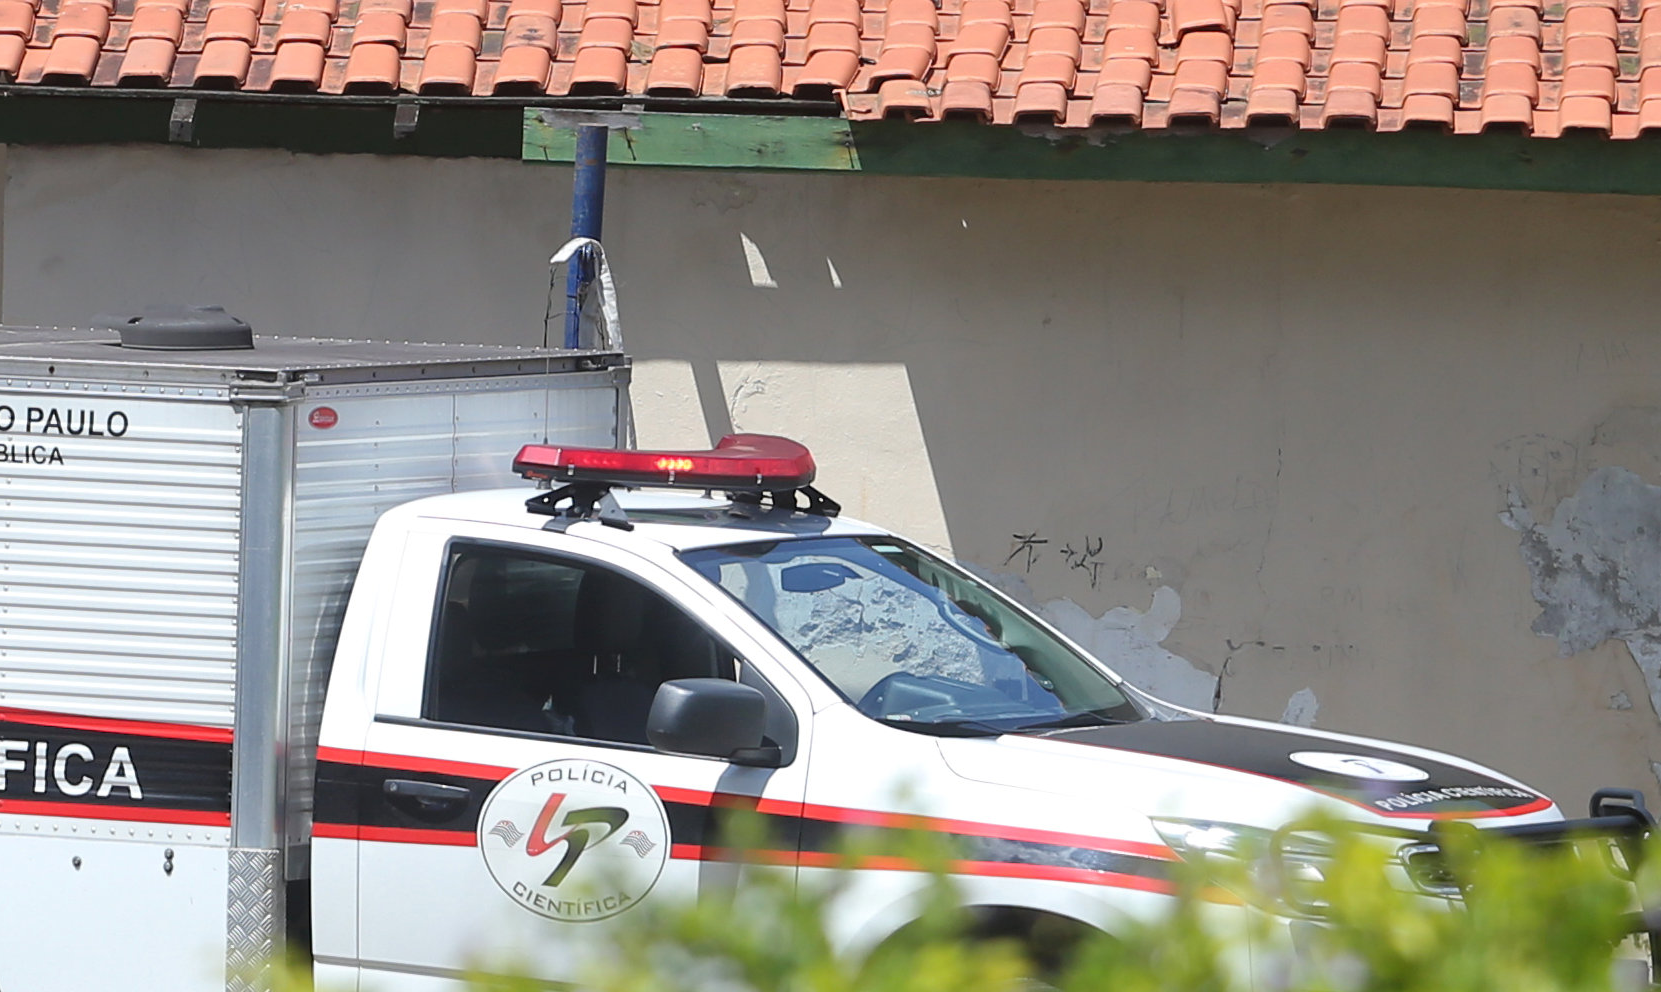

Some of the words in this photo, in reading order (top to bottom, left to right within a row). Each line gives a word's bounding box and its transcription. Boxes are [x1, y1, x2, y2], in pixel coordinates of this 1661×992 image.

[26, 407, 129, 437] PAULO
[530, 765, 628, 794] POLÍCIA
[1374, 790, 1451, 811] POLÍCIA
[512, 880, 632, 916] CIENTÍFICA
